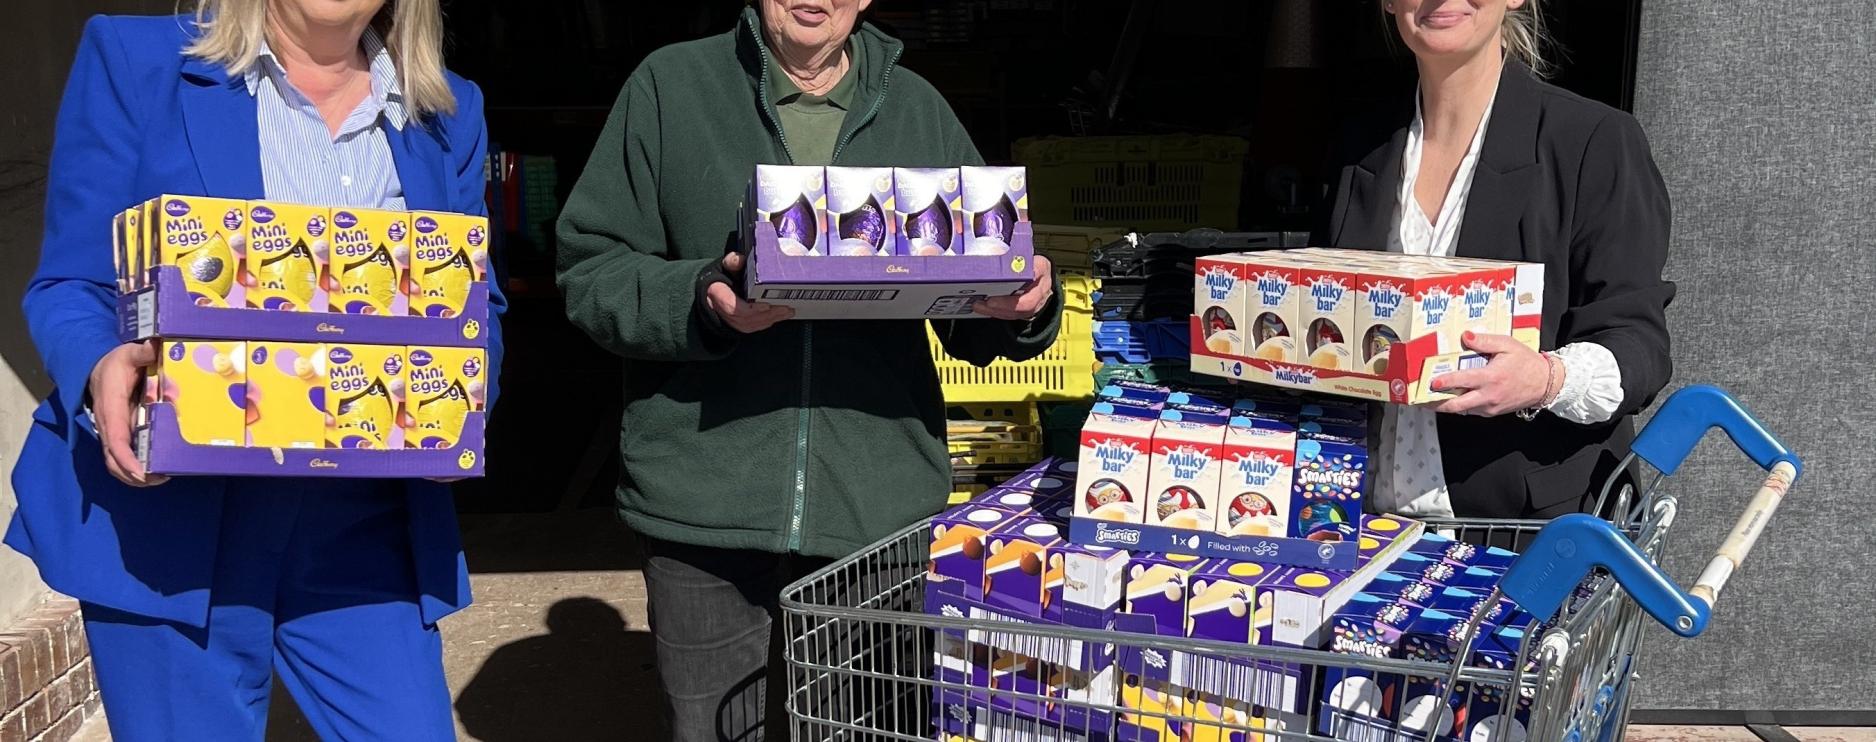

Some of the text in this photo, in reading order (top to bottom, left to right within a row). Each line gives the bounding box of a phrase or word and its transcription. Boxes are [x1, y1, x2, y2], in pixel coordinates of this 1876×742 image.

[166, 216, 202, 233] Mini
[251, 222, 287, 239] Mini
[167, 231, 208, 246] eggs
[335, 228, 368, 244] Mini
[415, 233, 448, 248] Mini
[252, 238, 291, 252] eggs
[336, 242, 373, 257] eggs
[416, 246, 453, 260] eggs
[1205, 274, 1234, 290] Milky
[1258, 280, 1287, 296] Milky
[1211, 287, 1228, 300] bar
[1263, 292, 1280, 305] bar
[1311, 284, 1343, 301] Milky
[1368, 290, 1401, 307] Milky
[1465, 289, 1490, 305] Milky
[1317, 299, 1336, 311] bar
[1422, 294, 1449, 311] Milky
[1375, 303, 1395, 318] bar
[1427, 311, 1443, 325] bar
[1469, 304, 1484, 318] bar
[330, 363, 364, 379] Mini
[410, 365, 443, 381] Mini
[1276, 370, 1313, 384] Milkybar
[331, 376, 369, 392] eggs
[411, 378, 448, 393] eggs
[1096, 446, 1134, 463] Milky
[1167, 453, 1206, 470] Milky
[1102, 458, 1125, 472] bar
[1174, 465, 1198, 479] bar
[1238, 460, 1279, 476] Milky
[1245, 472, 1269, 486] bar
[1171, 534, 1177, 545] 1
[1207, 541, 1251, 553] Filled with
